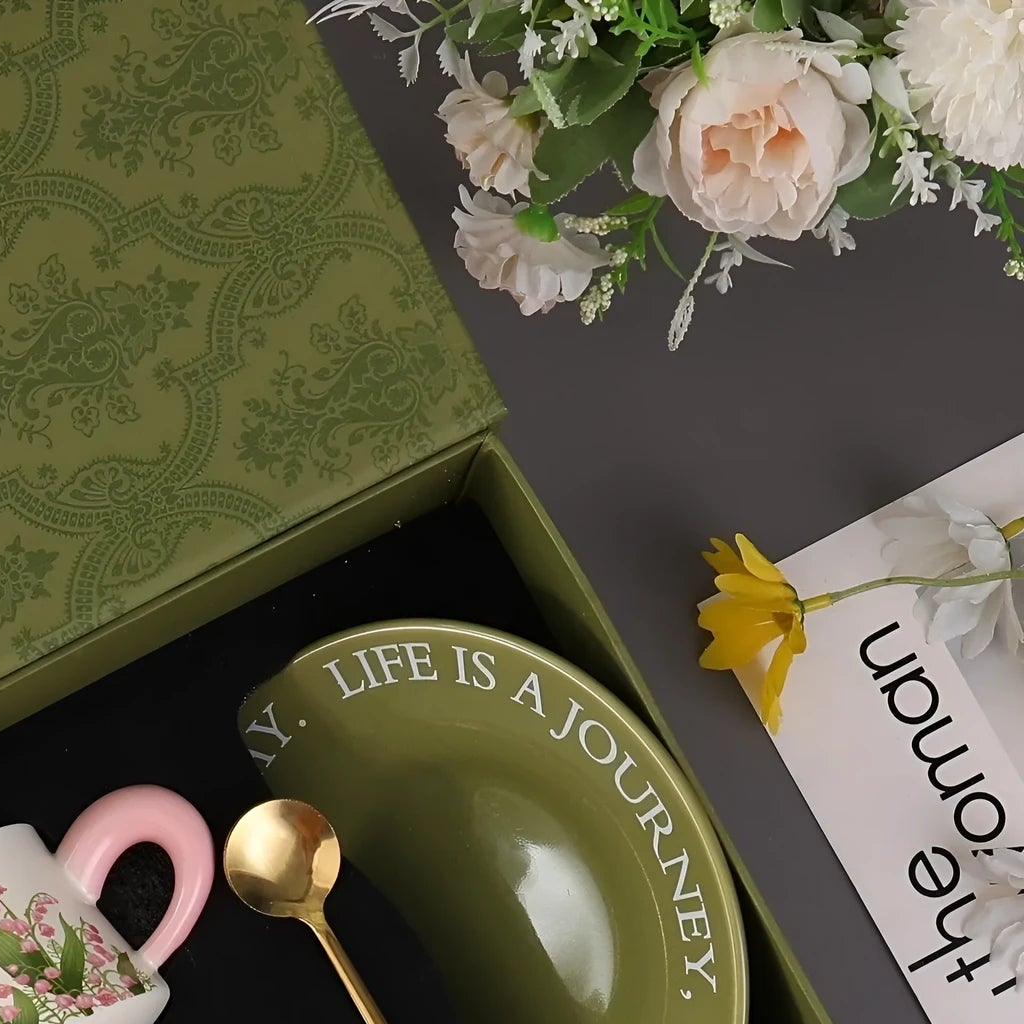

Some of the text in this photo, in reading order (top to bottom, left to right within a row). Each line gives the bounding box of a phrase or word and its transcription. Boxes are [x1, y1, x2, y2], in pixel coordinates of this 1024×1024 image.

[322, 642, 437, 699] LIFE
[452, 646, 496, 691] IS
[510, 672, 546, 717] A
[549, 698, 717, 1000] JOURNEY,
[859, 621, 1024, 897] oman
[908, 846, 991, 984] the
